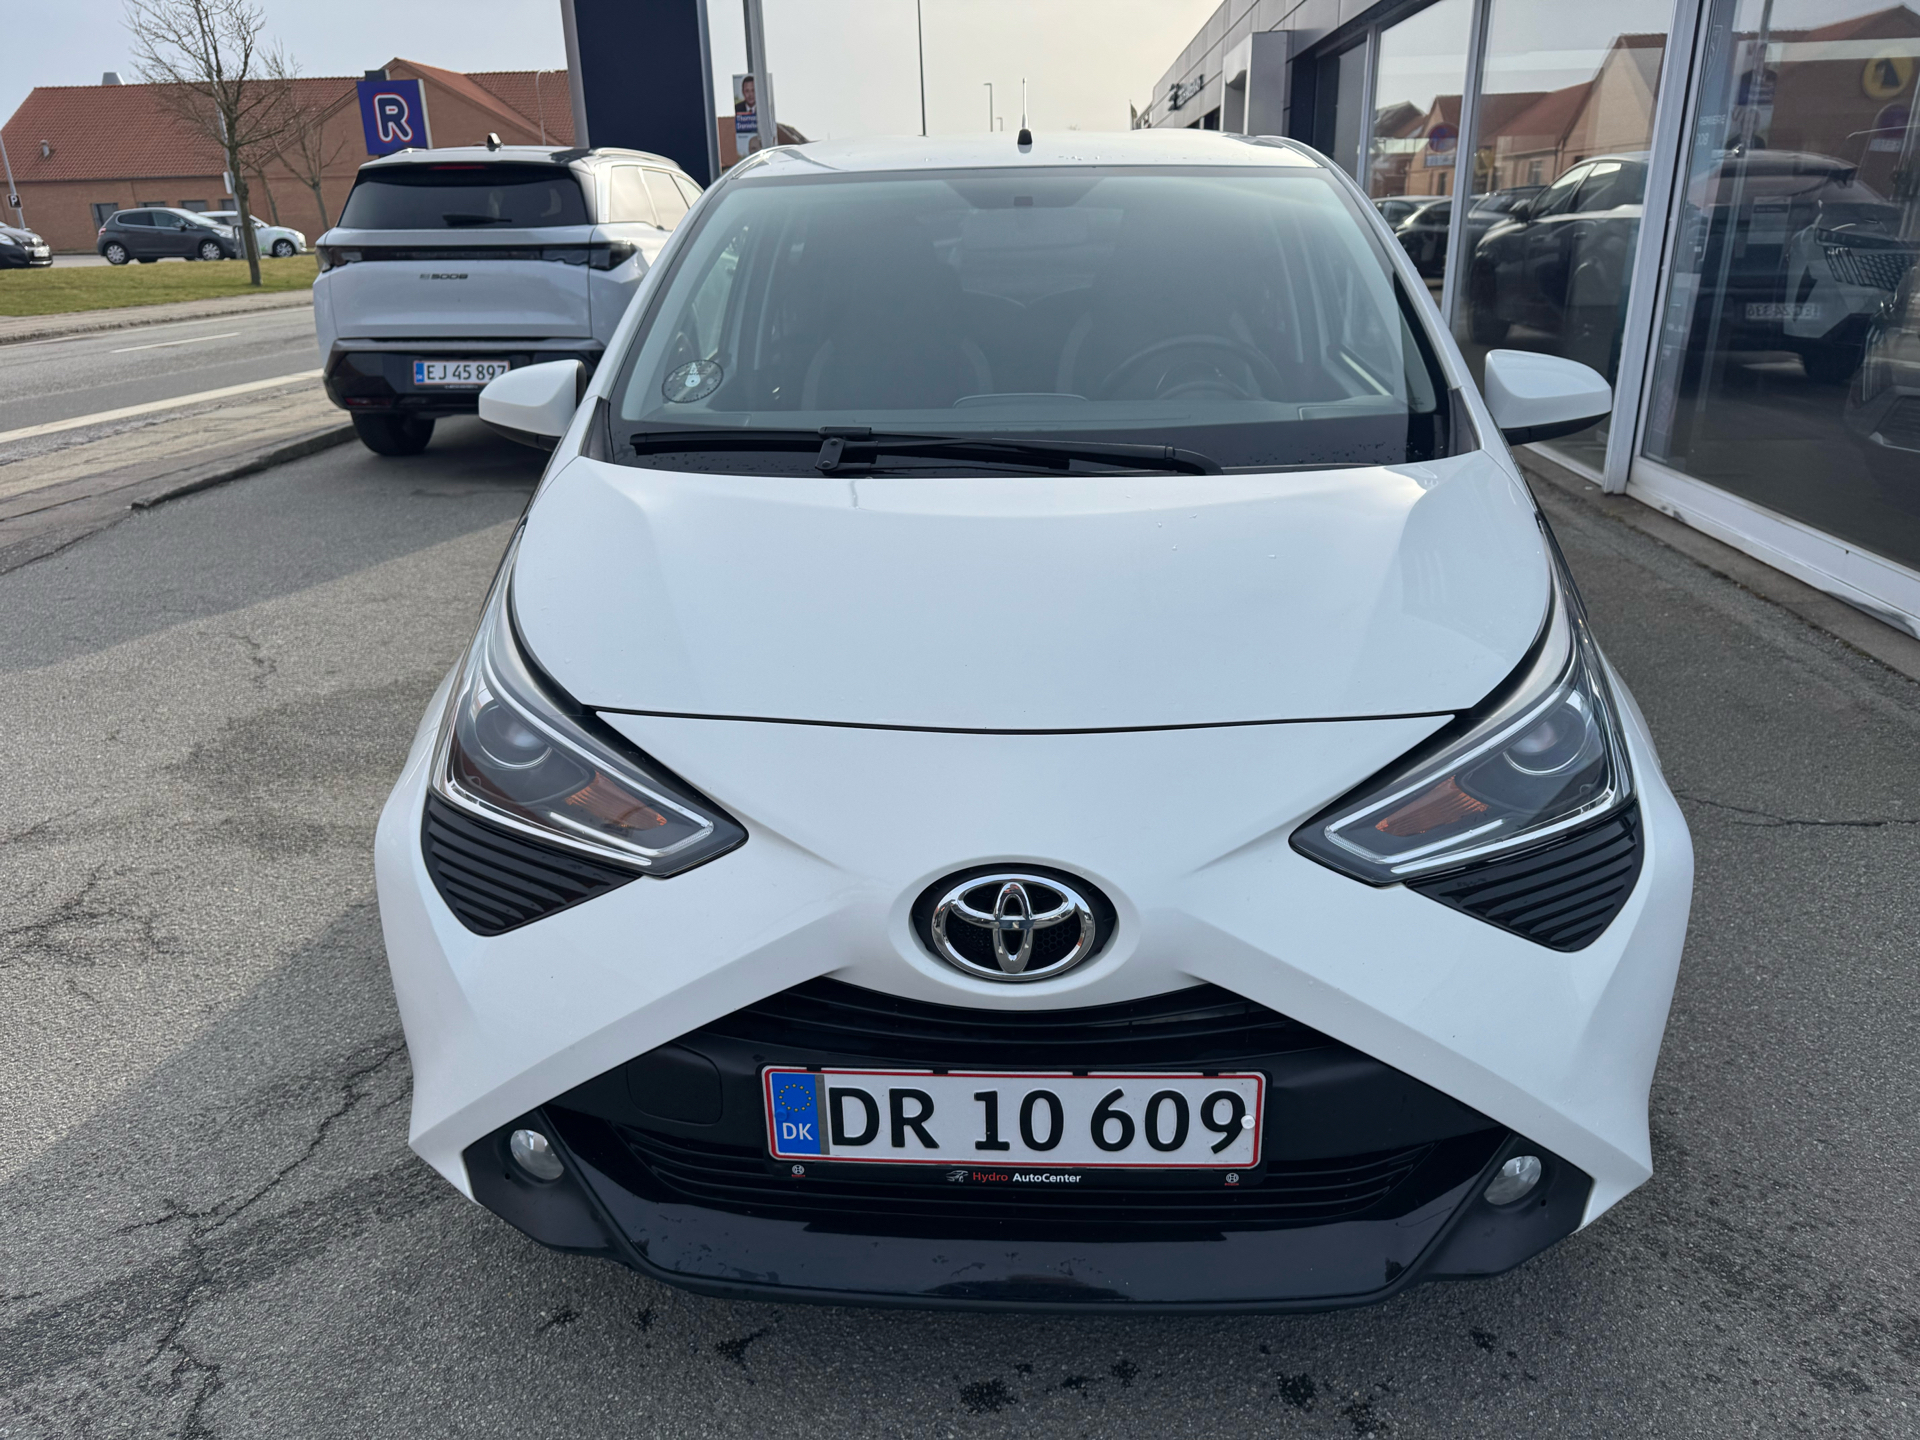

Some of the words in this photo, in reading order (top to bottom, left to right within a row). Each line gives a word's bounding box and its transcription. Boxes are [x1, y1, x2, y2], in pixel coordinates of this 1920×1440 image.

[373, 92, 413, 143] R
[427, 364, 447, 380] EJ
[452, 364, 471, 380] 45
[476, 364, 507, 380] 897
[829, 1086, 940, 1149] DR
[973, 1089, 1064, 1151] 10
[1090, 1086, 1246, 1154] 609
[782, 1122, 813, 1141] DK
[972, 1172, 1008, 1183] Hydro
[1012, 1172, 1082, 1183] AutoCenter
